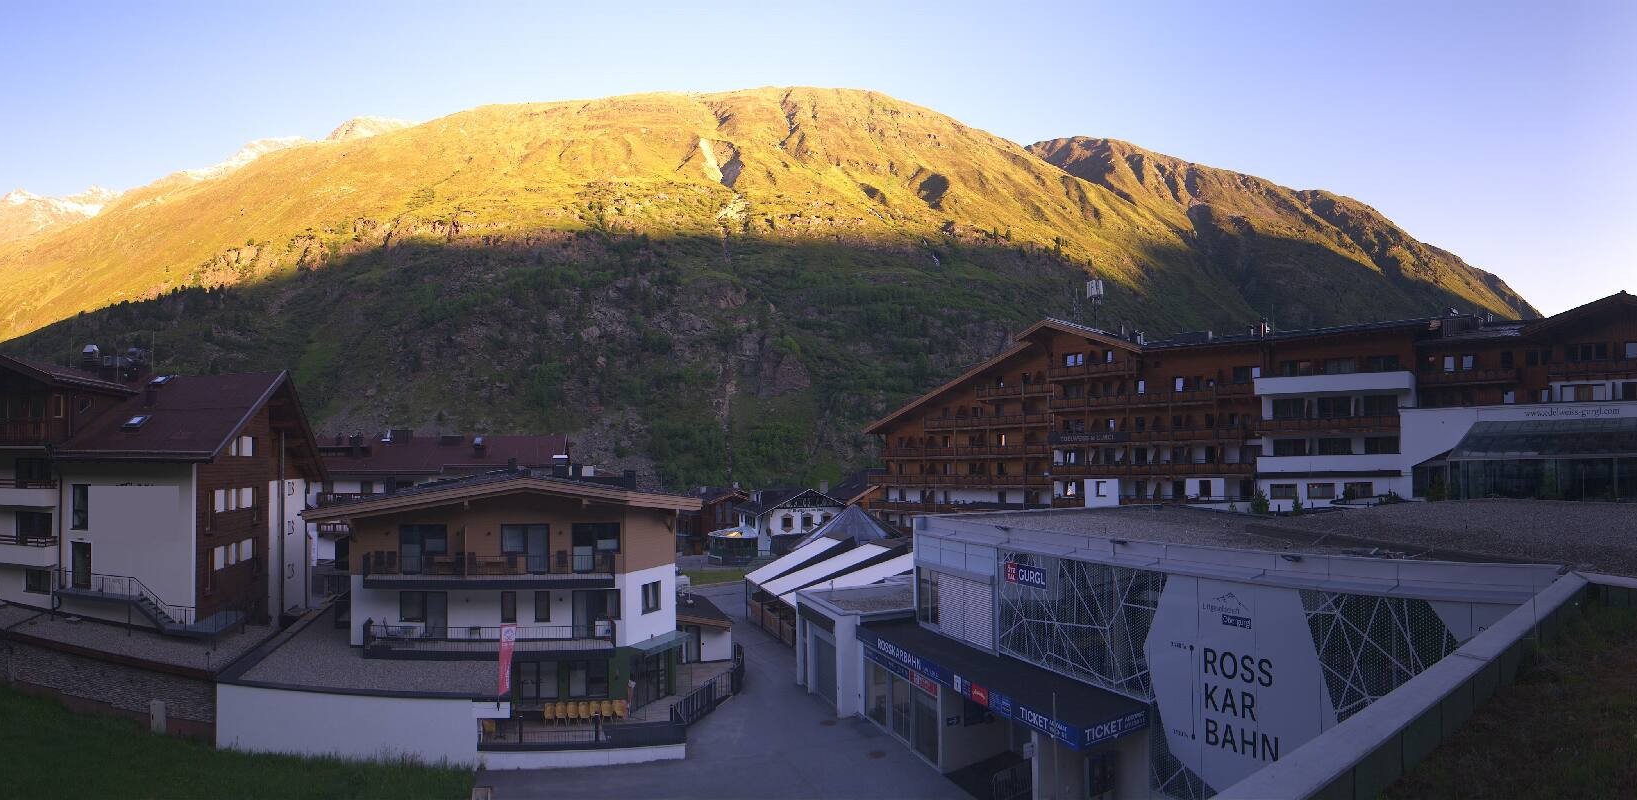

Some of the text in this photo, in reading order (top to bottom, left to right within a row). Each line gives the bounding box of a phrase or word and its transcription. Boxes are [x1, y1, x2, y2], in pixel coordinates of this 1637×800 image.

[1018, 568, 1046, 586] GURGL
[876, 637, 922, 671] ROSSKARBAHN
[1203, 647, 1273, 688] ROSS
[1019, 706, 1049, 730] TICKET
[1205, 682, 1257, 722] KAR
[1084, 718, 1124, 742] TICKET
[1206, 717, 1279, 762] BAHN
